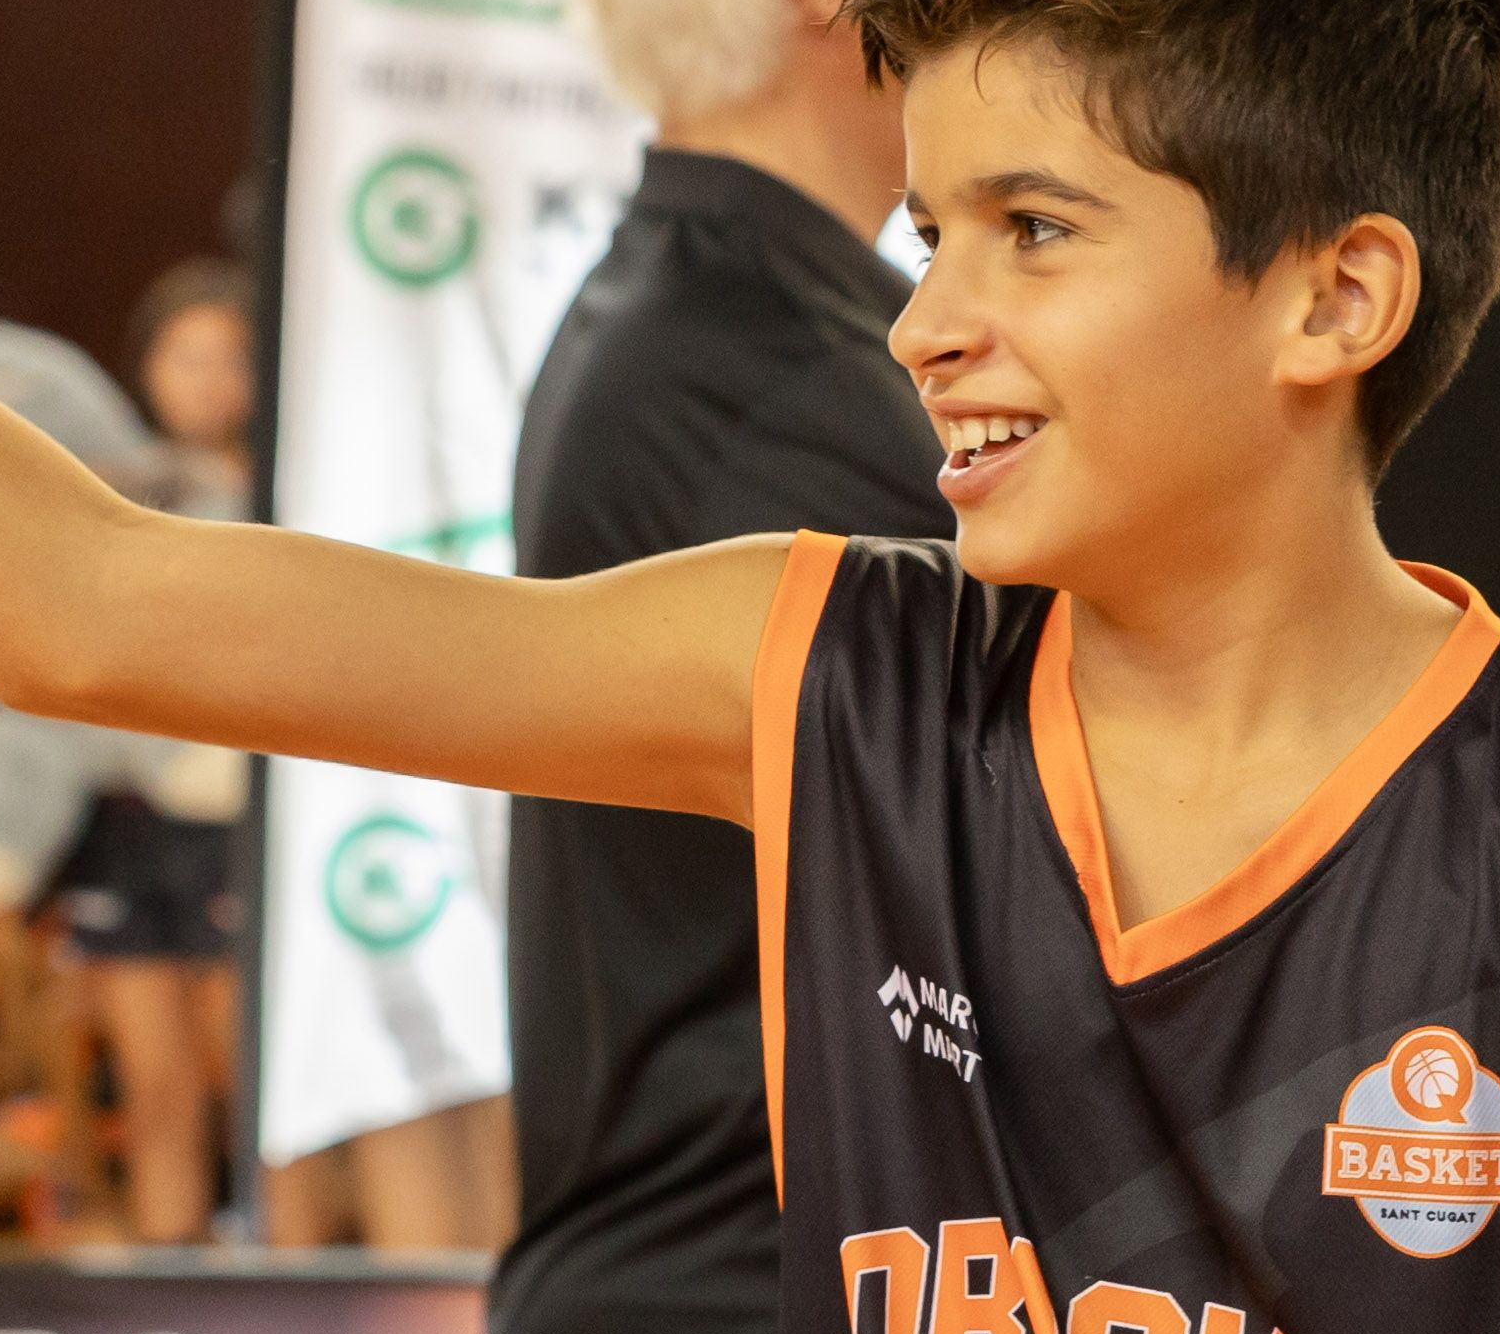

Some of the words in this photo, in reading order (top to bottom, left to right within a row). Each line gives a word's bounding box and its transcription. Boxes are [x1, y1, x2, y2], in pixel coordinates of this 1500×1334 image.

[920, 976, 978, 1035] MAR
[1380, 1208, 1420, 1222] SANT
[1426, 1210, 1477, 1224] CUGAT
